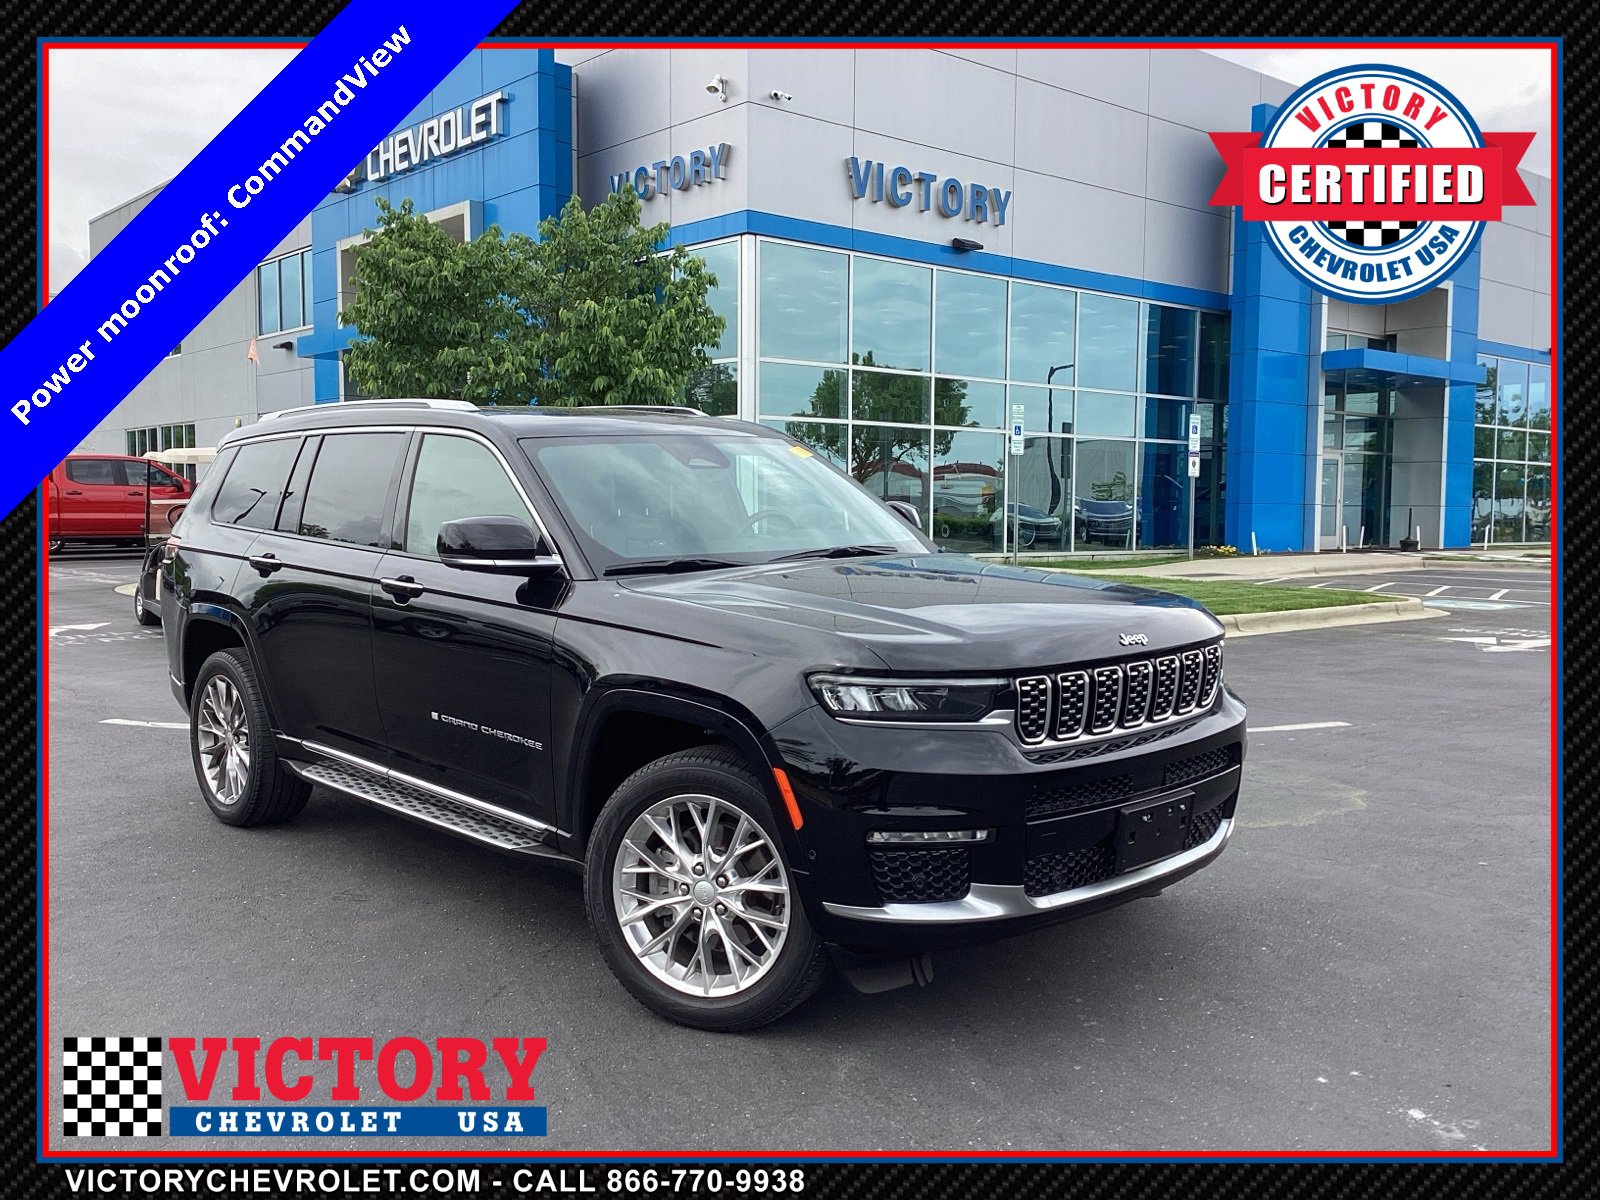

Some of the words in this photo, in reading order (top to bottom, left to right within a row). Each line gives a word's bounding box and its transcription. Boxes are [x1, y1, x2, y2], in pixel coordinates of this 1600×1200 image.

[366, 91, 504, 182] CHEVROLET
[845, 156, 1012, 226] VICTORY
[1119, 633, 1149, 646] Jeep
[440, 714, 478, 731] GRAND
[481, 725, 543, 750] CHEROKEE
